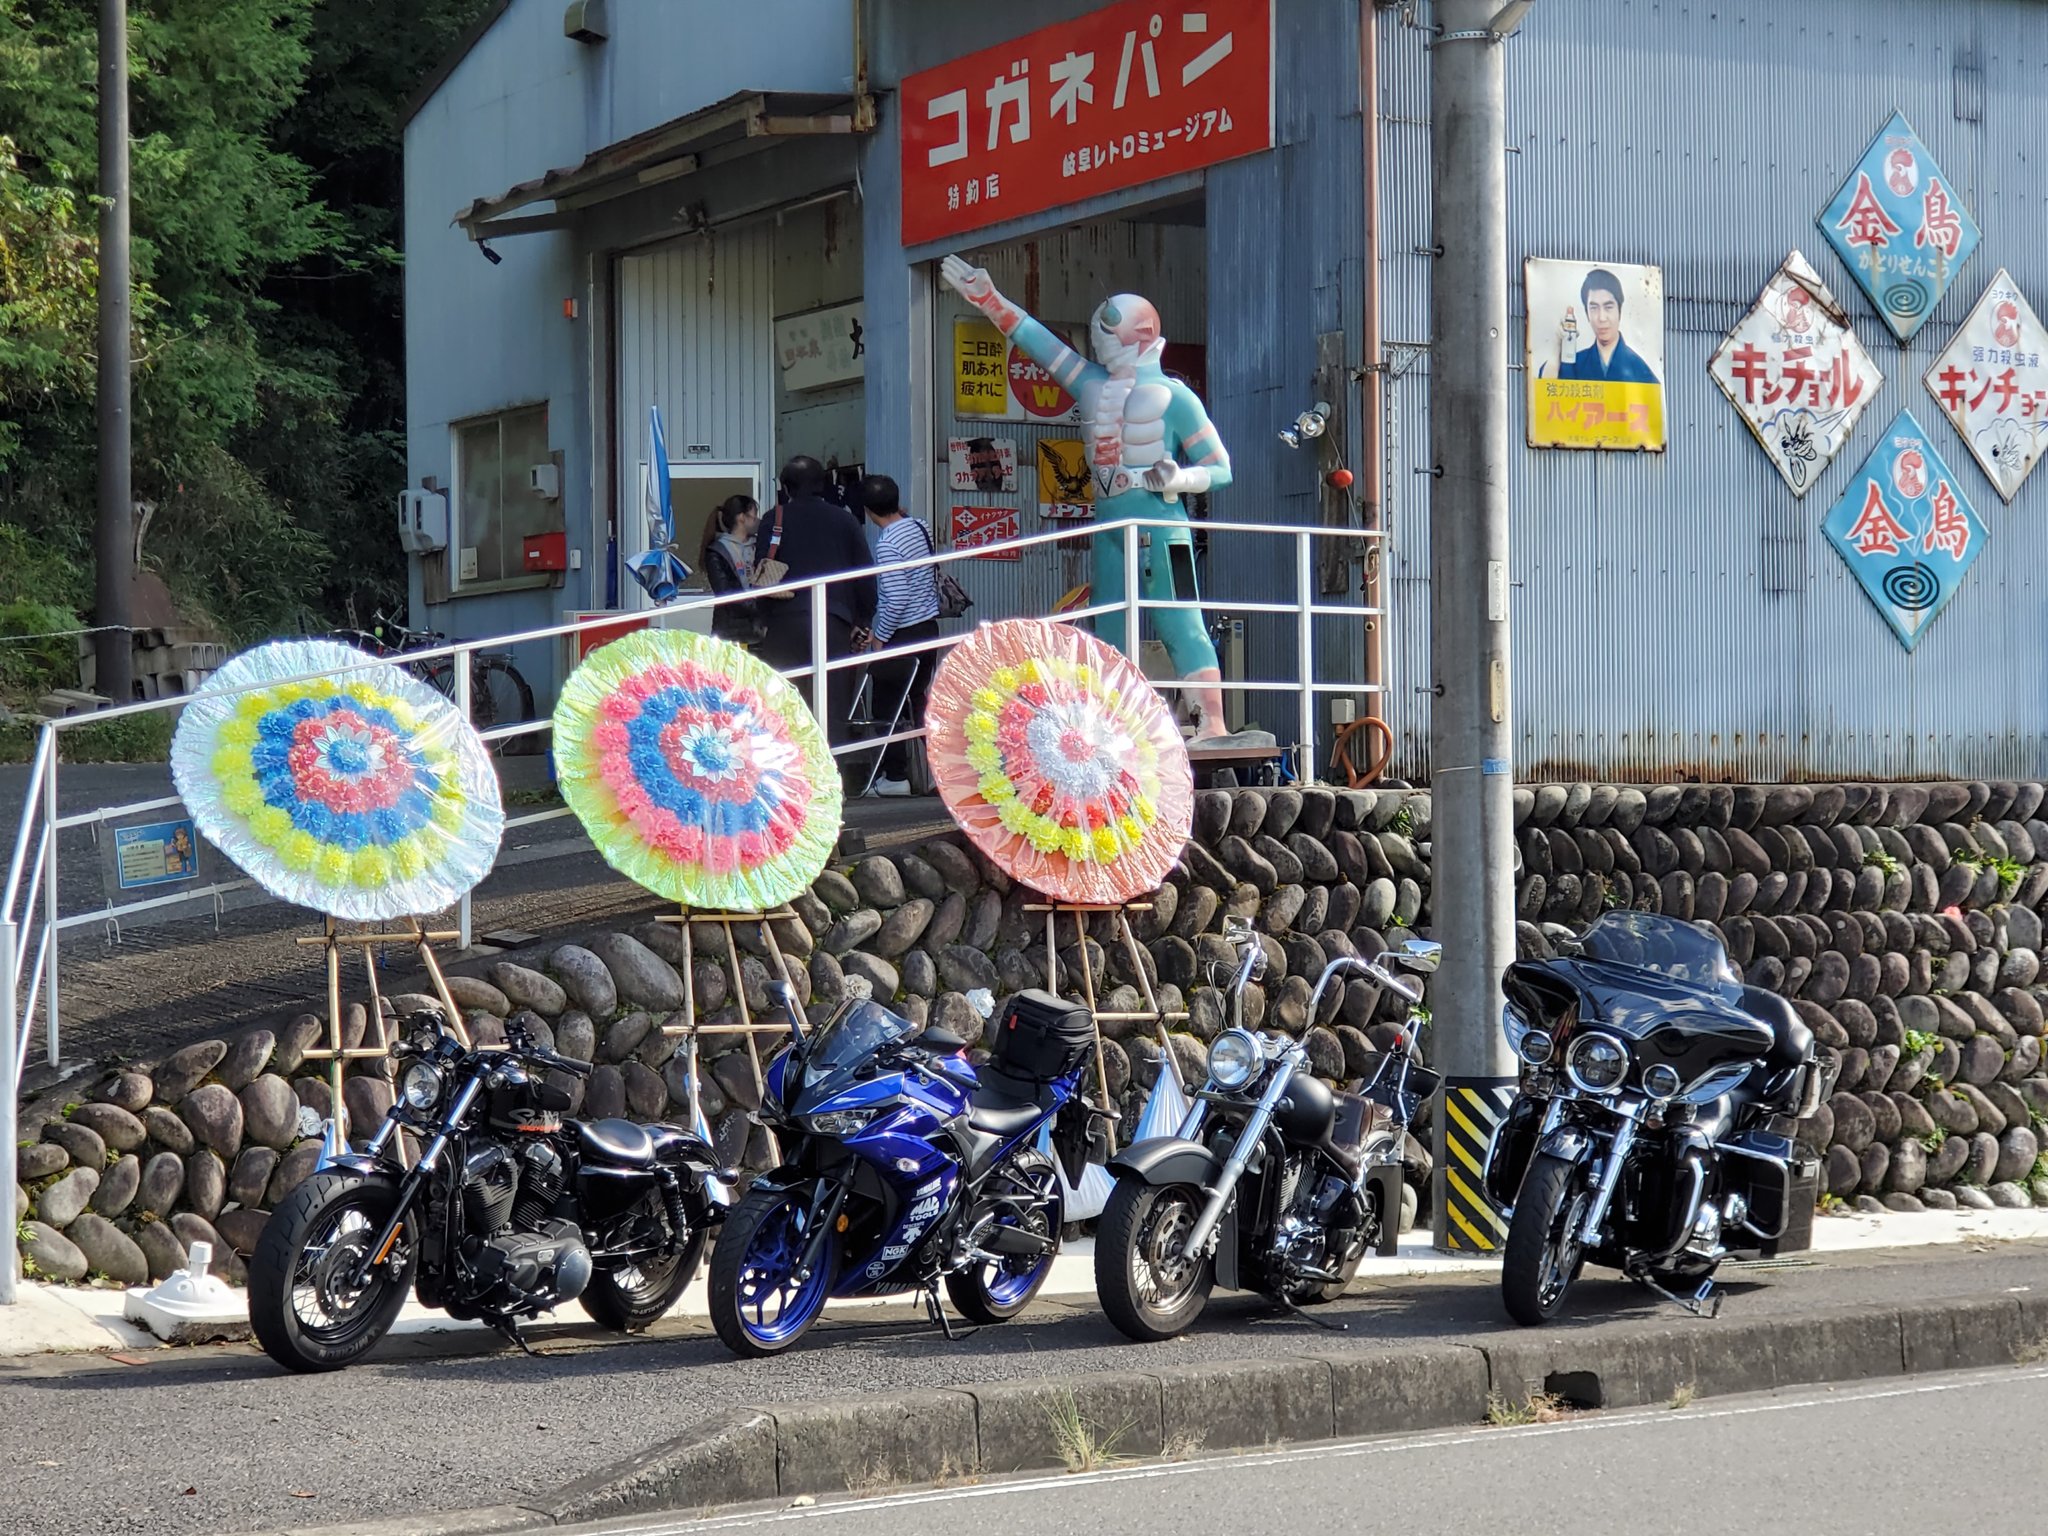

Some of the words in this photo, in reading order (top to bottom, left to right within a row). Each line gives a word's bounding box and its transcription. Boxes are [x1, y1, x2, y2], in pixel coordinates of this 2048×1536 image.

[928, 13, 1233, 168] コガネパン
[1062, 107, 1233, 178] 岐阜レトロミュージアム
[947, 173, 1000, 211] 特約店
[1835, 170, 1963, 261] 金鳥
[961, 340, 1003, 358] 二日酔
[961, 360, 1003, 377] 肌あれ
[1731, 342, 1865, 409] キンチョール
[960, 381, 1003, 397] 疲れに
[1032, 385, 1060, 408] W
[1938, 364, 2048, 417] キンチョー
[1546, 401, 1650, 433] ハイアース
[1844, 476, 1971, 562] 金鳥
[910, 1208, 939, 1222] TOOLS
[884, 1247, 907, 1257] NGK
